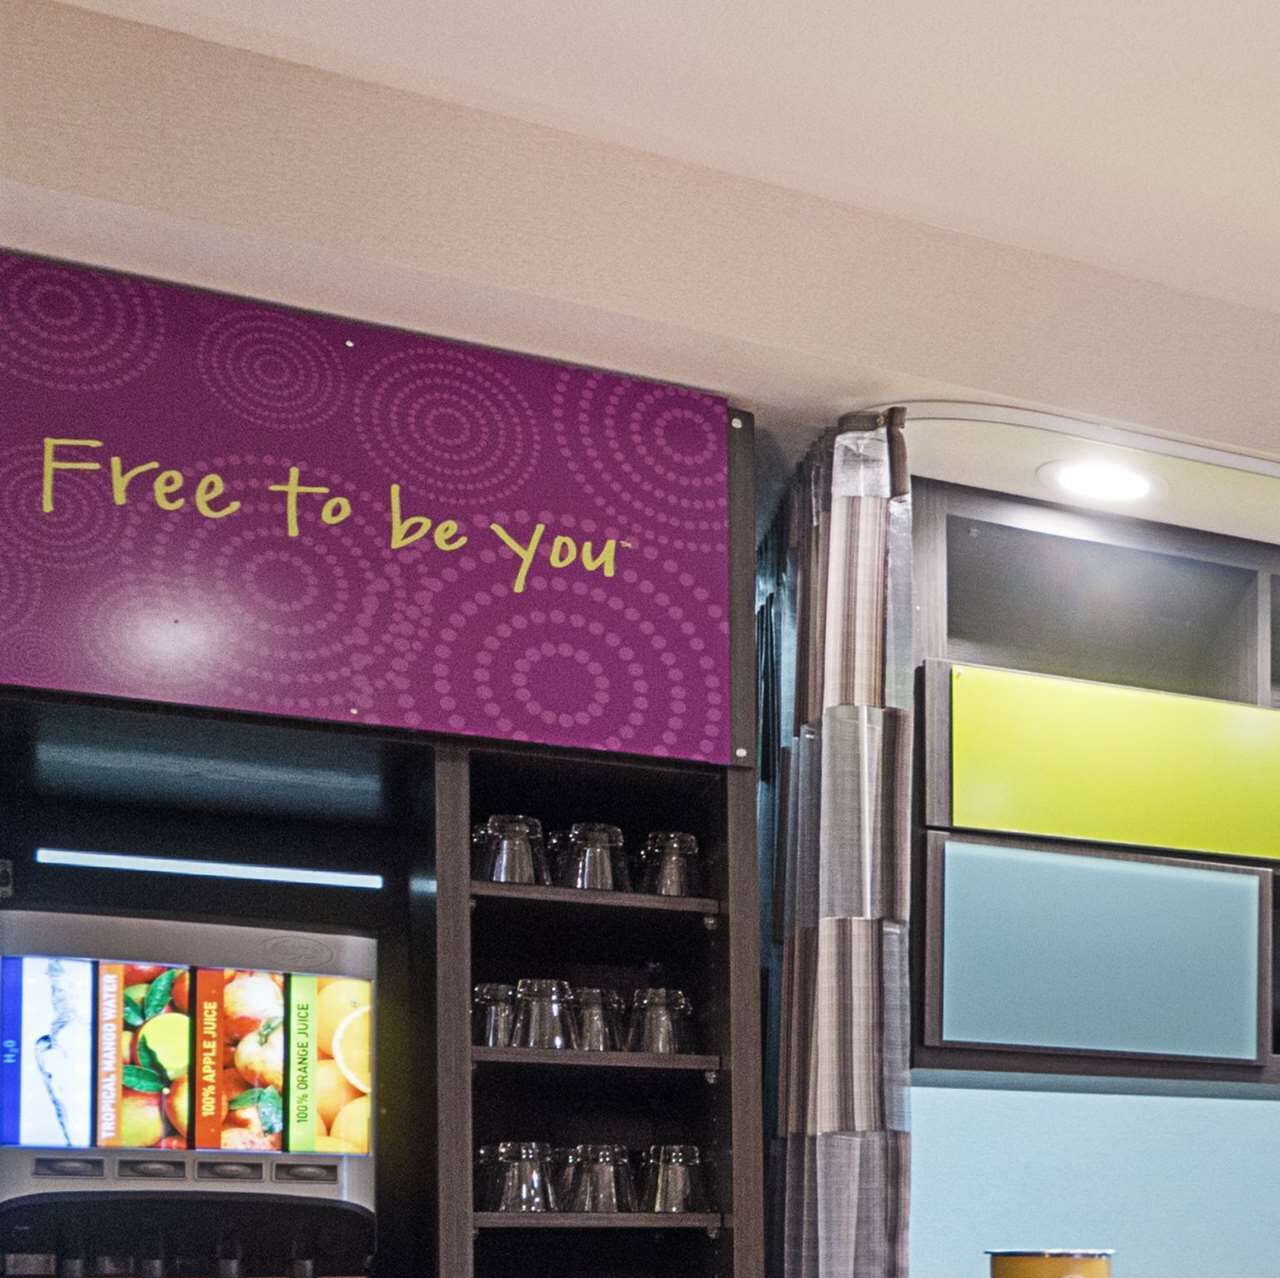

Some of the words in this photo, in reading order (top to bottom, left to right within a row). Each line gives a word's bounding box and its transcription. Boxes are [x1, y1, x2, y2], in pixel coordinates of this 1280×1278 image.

[42, 438, 240, 518] Free
[268, 467, 352, 537] to
[390, 485, 468, 550] be
[489, 522, 620, 593] you
[103, 973, 118, 1021] WATER
[203, 1001, 217, 1037] JUICE
[297, 1003, 309, 1038] JUICE
[103, 1023, 117, 1069] MANGO
[202, 1040, 216, 1083] APPLE
[296, 1042, 309, 1090] ORANGE
[101, 1071, 116, 1140] TROPICAL
[201, 1085, 215, 1117] 100%
[296, 1093, 308, 1124] 100%
